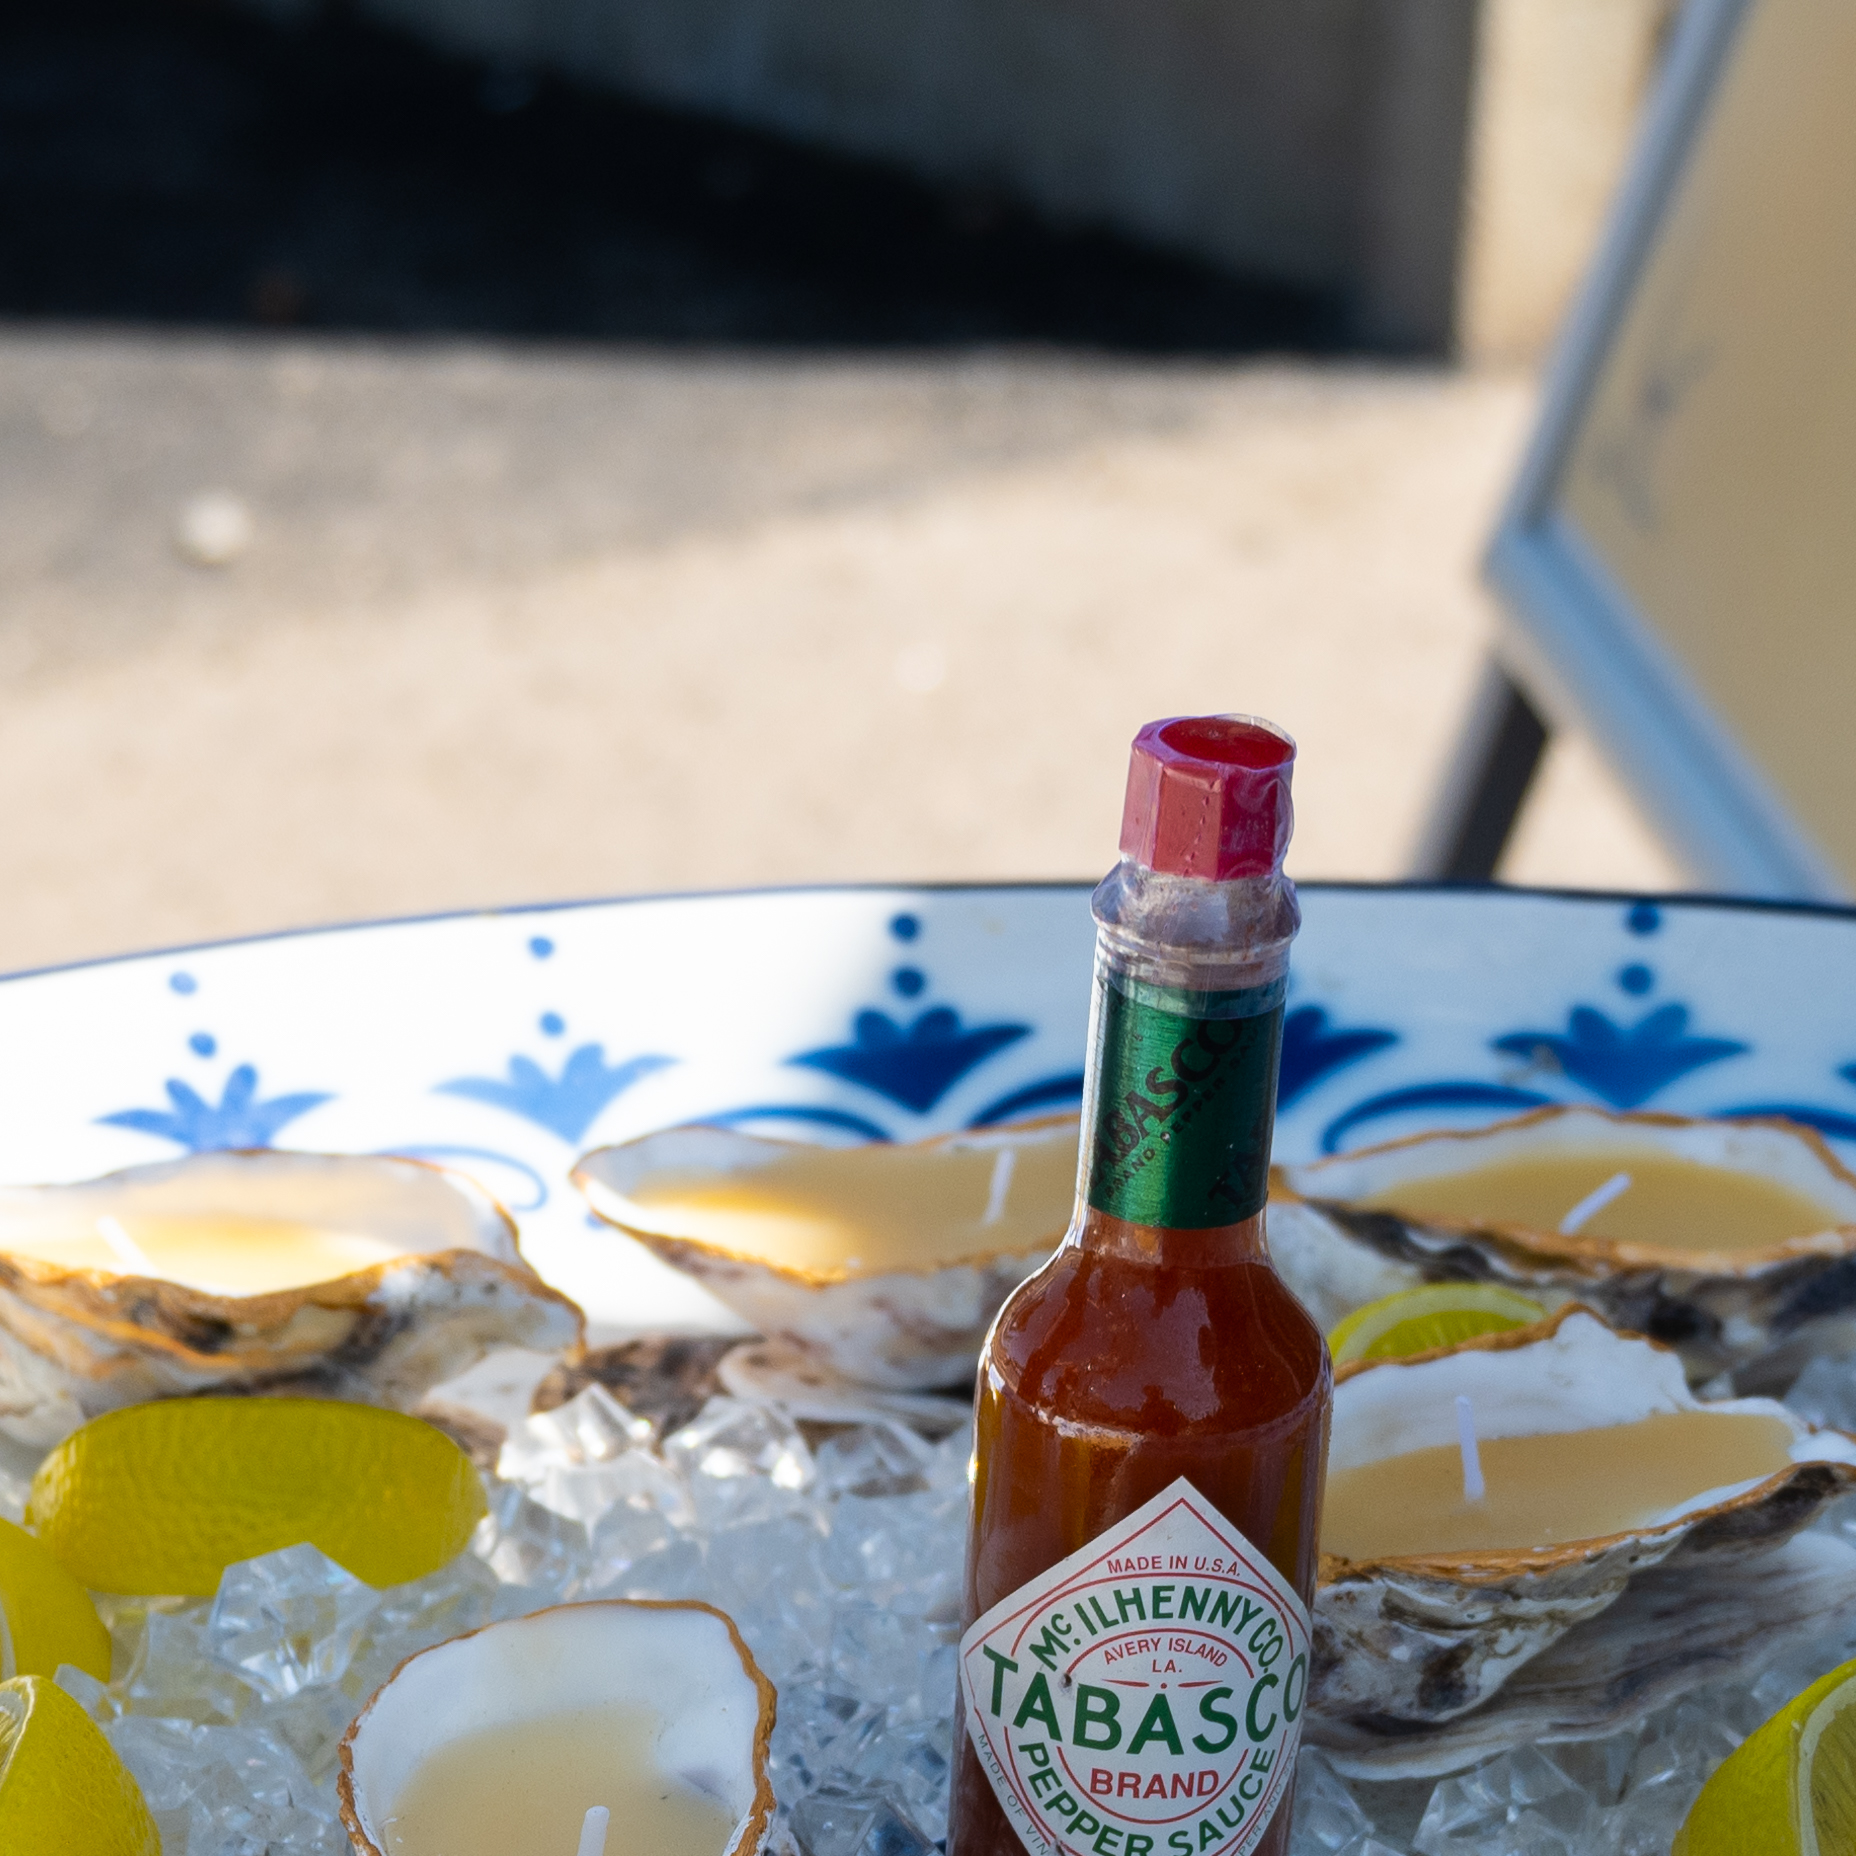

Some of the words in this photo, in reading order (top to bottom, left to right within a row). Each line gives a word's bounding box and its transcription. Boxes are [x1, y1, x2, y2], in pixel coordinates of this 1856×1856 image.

[1106, 1555, 1162, 1574] MADE
[1169, 1555, 1188, 1570] IN
[1194, 1555, 1241, 1577] U.S.A.
[1103, 1637, 1162, 1665] AVERY
[1168, 1637, 1228, 1667] ISLAND
[1151, 1659, 1183, 1673] LA.
[982, 1643, 1306, 1756] TABASCO
[978, 1733, 1007, 1787] MADE
[1006, 1794, 1026, 1818] OF
[1025, 1824, 1050, 1856] VIN
[1089, 1767, 1220, 1799] BRAND
